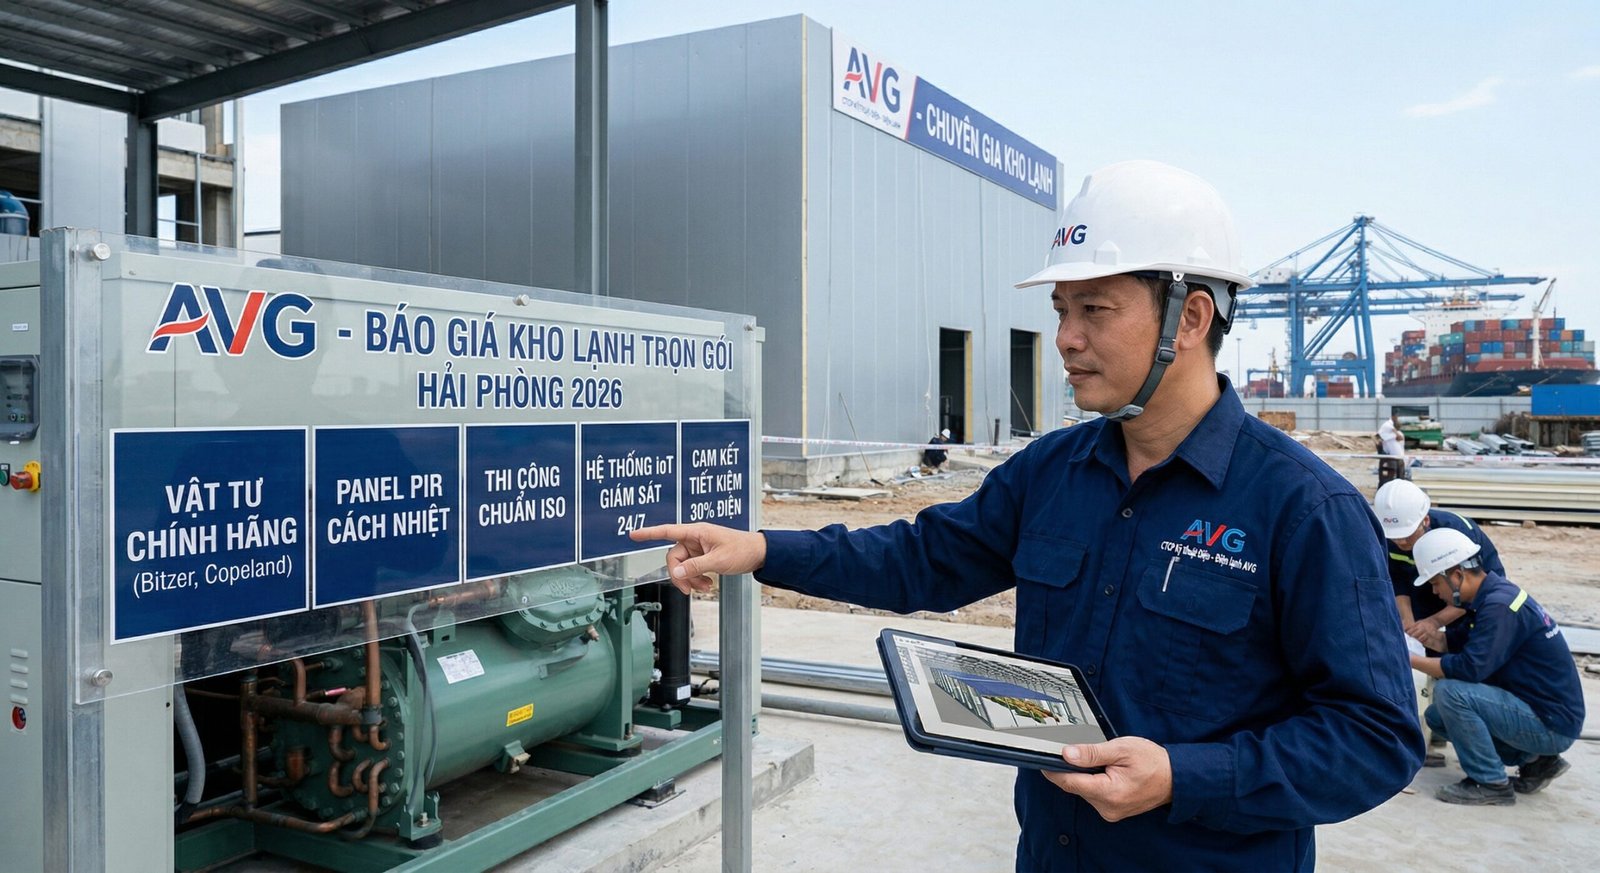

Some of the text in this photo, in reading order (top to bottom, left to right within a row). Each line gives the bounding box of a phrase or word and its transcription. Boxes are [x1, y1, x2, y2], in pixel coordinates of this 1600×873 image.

[843, 47, 900, 114] AVG
[926, 103, 979, 159] CHUYÊN
[982, 135, 1001, 170] GIA
[1004, 144, 1026, 181] KHO
[1028, 158, 1052, 195] LẠNH
[1051, 224, 1087, 250] AVG
[147, 282, 316, 359] AVG
[365, 303, 436, 356] BÁO
[448, 312, 499, 359] GIÁ
[509, 323, 564, 362] KHO
[573, 329, 634, 370] LẠNH
[642, 335, 695, 374] TRỌN
[702, 334, 733, 370] GÓI
[418, 362, 622, 409] HẢI PHÒNG 2026
[586, 455, 604, 484] HỆ
[608, 450, 652, 478] THỐNG
[692, 442, 739, 469] CAM KẾT
[337, 473, 443, 504] PANEL PIR
[485, 462, 560, 492] THI CÔNG
[689, 470, 742, 496] TIẾT KIỆM
[165, 476, 263, 518] VẬT TƯ
[479, 491, 566, 526] CHUẨN ISO
[600, 481, 662, 509] GIÁM SÁT
[690, 495, 742, 521] 30% ĐIỆN
[127, 513, 297, 562] CHÍNH HÃNG
[327, 504, 450, 544] CÁCH NHIỆT
[617, 513, 646, 536] 24/7
[1180, 519, 1246, 553] AVG
[1161, 541, 1175, 551] CTCP
[1242, 561, 1258, 573] AVG
[133, 555, 293, 599] (Bitzer, Copeland)
